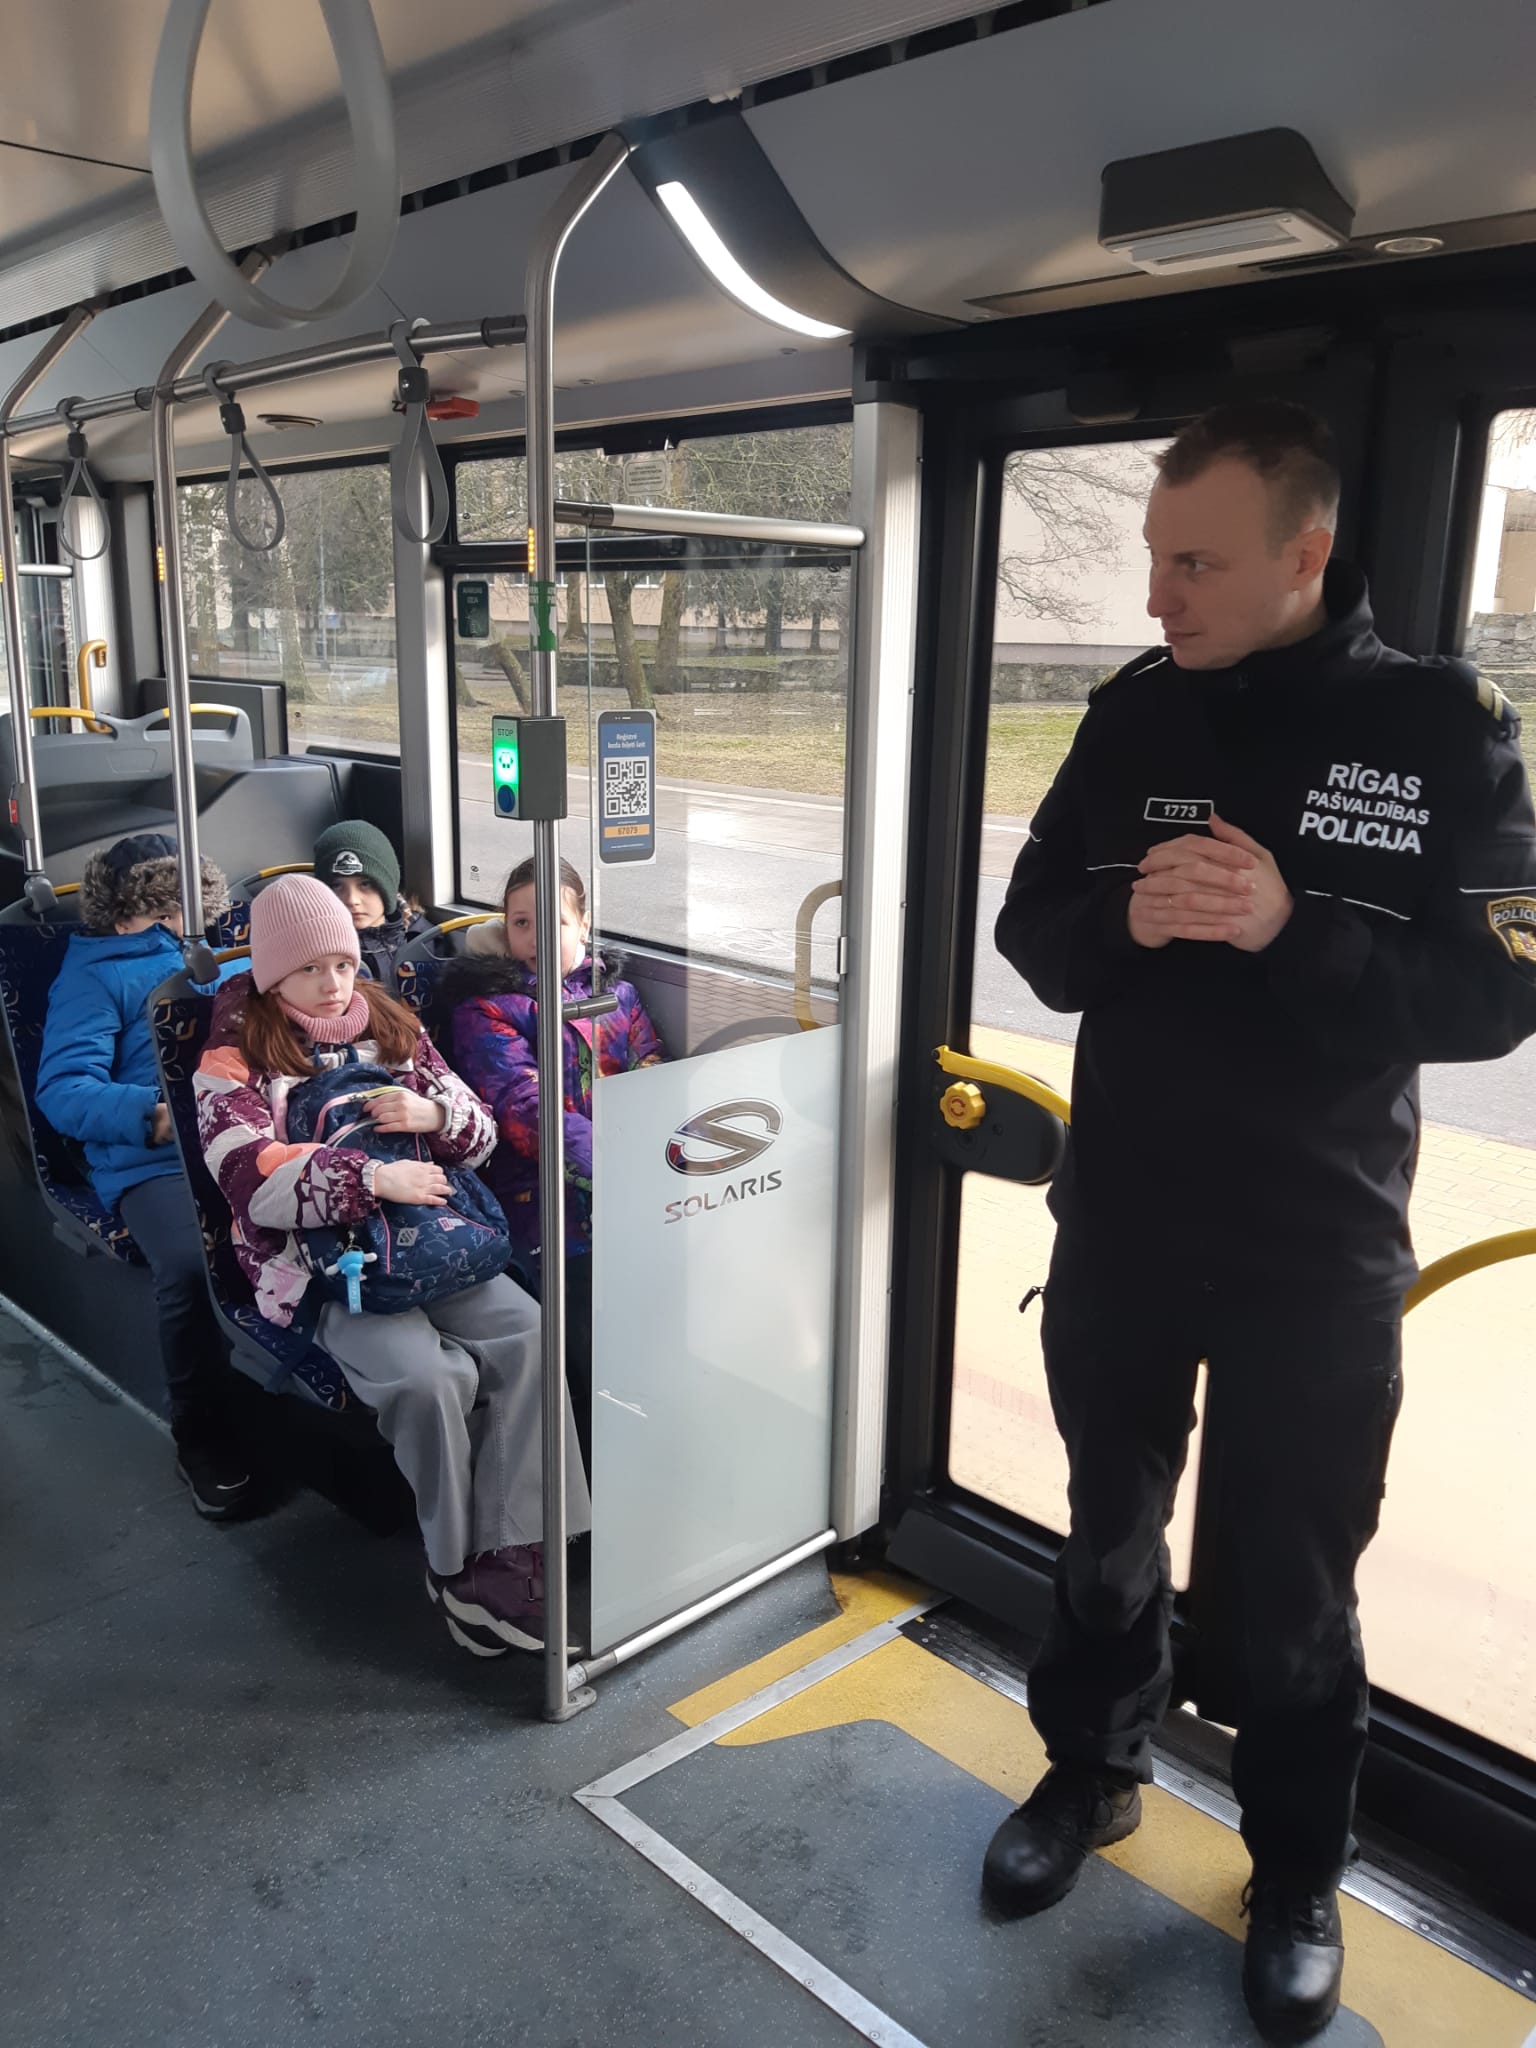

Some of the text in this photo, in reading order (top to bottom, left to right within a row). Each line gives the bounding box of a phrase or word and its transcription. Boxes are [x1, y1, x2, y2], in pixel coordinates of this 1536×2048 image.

[497, 728, 514, 737] STOP
[1327, 763, 1422, 801] RĪGAS
[1164, 804, 1198, 818] 1773
[1306, 790, 1430, 825] PAŠVALDĪBAS
[1298, 811, 1422, 854] POLICIJA
[664, 1170, 782, 1224] SOLARIS
